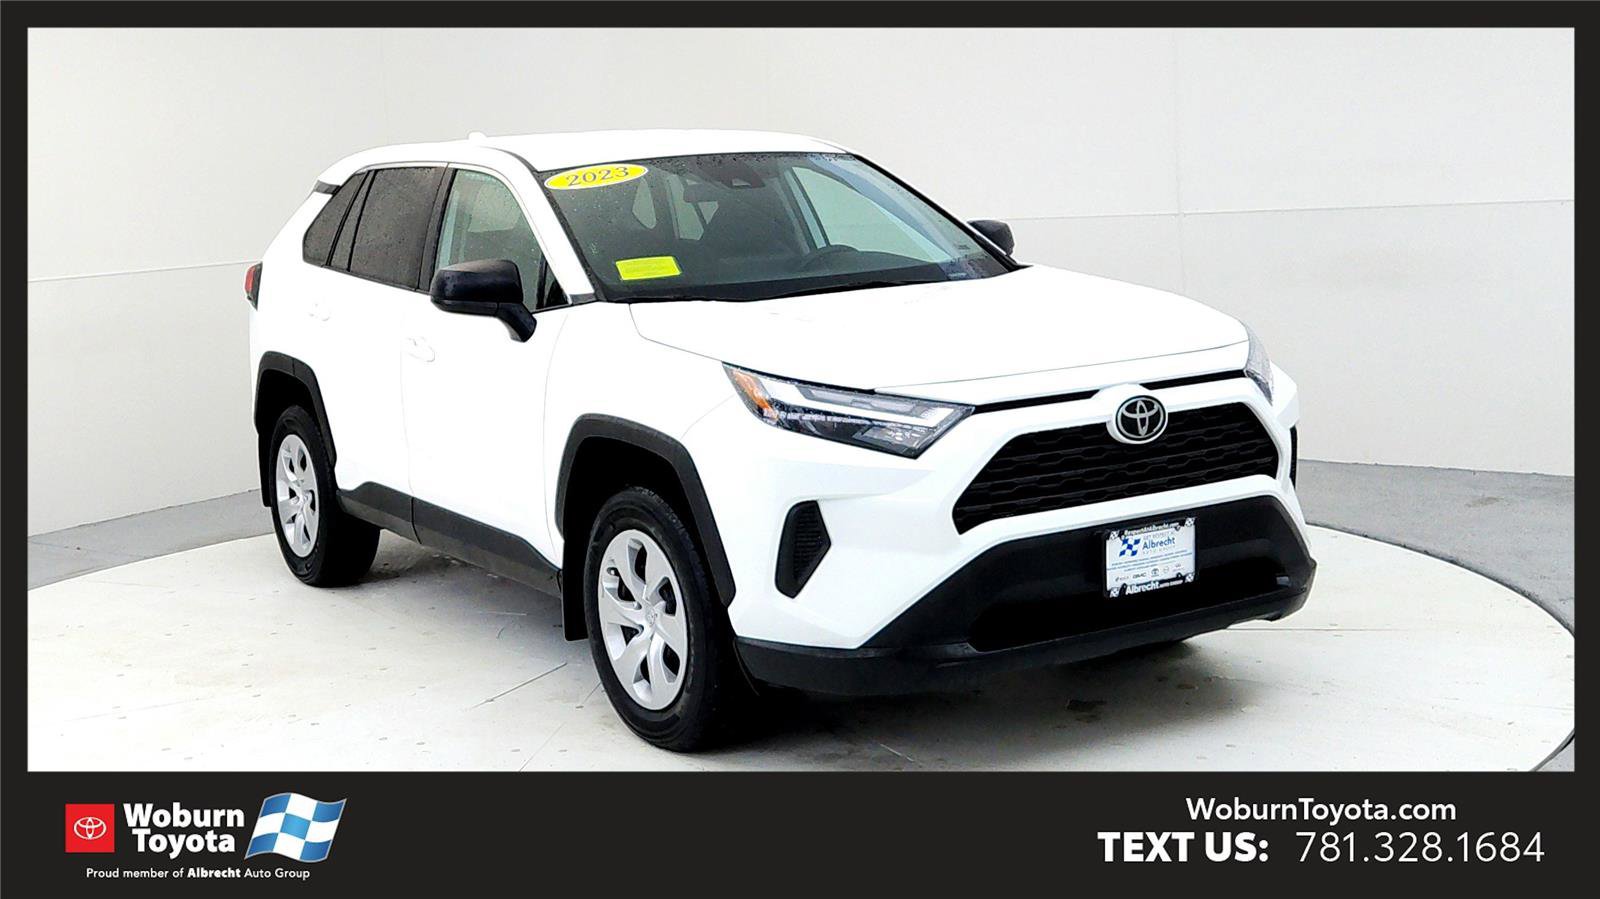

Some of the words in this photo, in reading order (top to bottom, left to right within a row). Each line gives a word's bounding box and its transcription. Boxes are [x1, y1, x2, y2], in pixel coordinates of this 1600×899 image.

[566, 166, 629, 187] 2023
[1142, 537, 1176, 550] Albrecht
[1125, 580, 1159, 595] Albrecht
